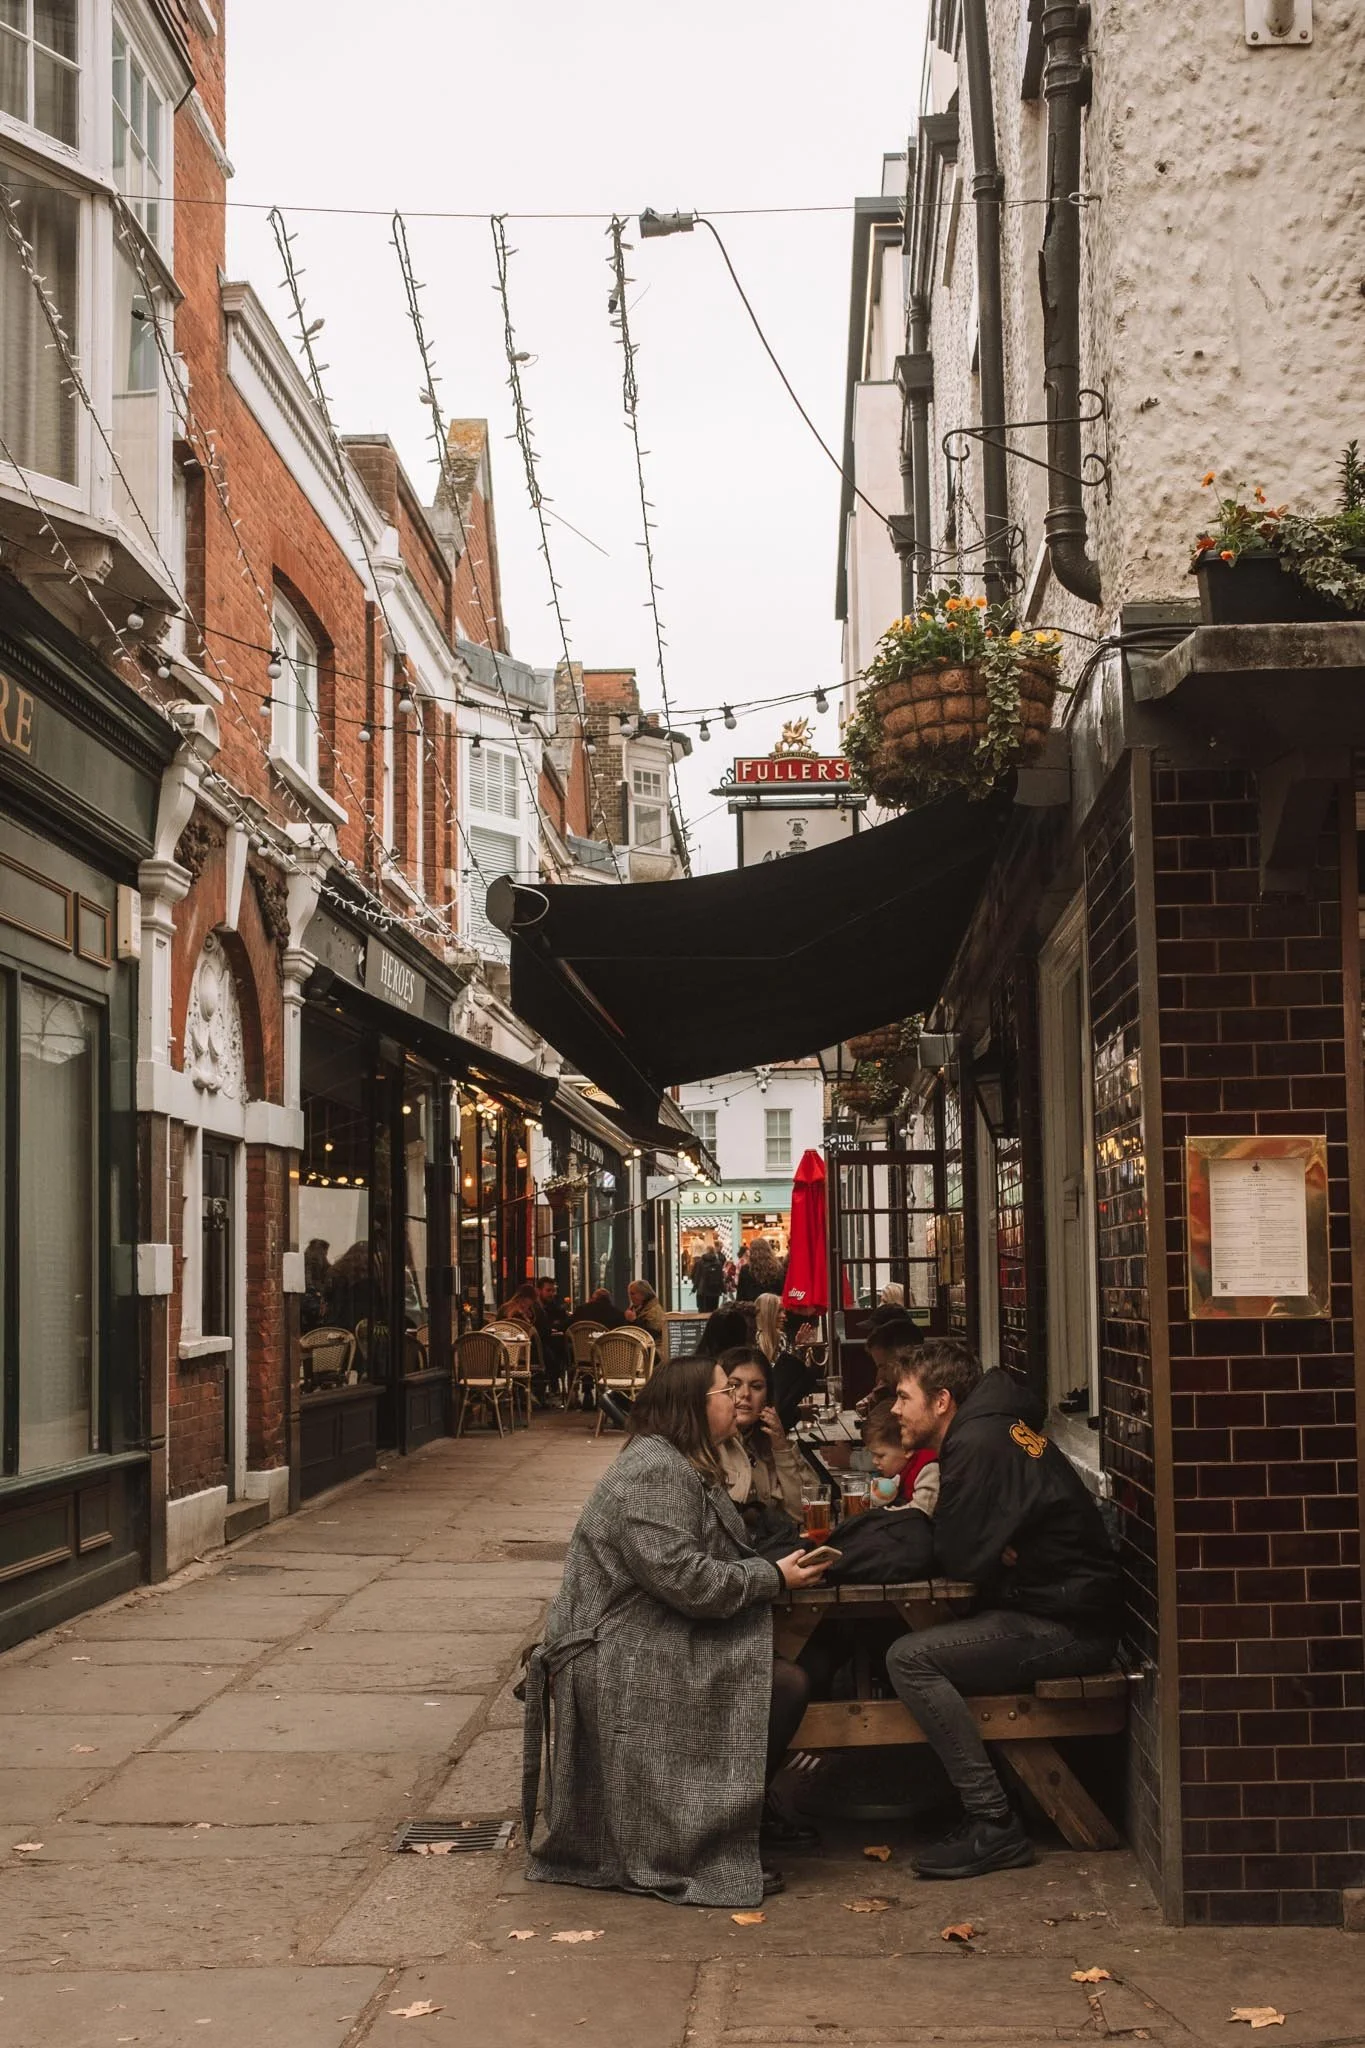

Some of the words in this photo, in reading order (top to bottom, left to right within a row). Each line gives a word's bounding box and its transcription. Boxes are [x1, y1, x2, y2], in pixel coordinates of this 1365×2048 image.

[741, 759, 845, 781] FULLER'S
[380, 949, 415, 1004] HEROES
[692, 1190, 762, 1204] BONAS
